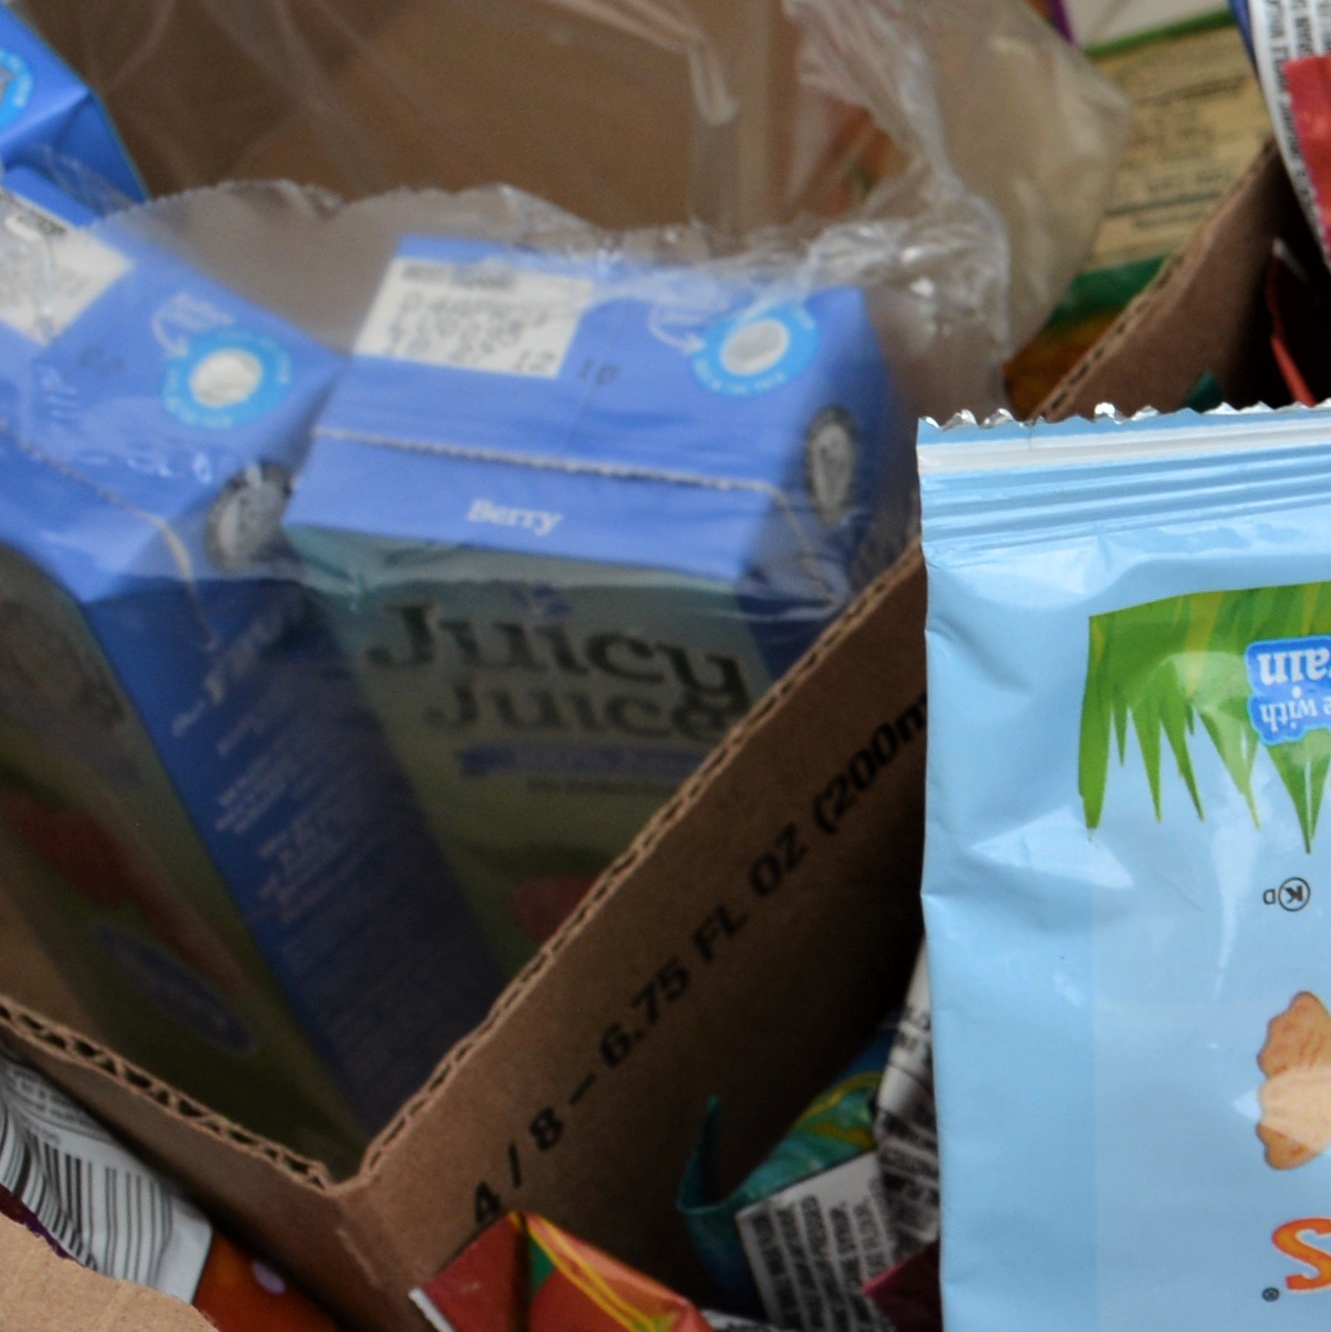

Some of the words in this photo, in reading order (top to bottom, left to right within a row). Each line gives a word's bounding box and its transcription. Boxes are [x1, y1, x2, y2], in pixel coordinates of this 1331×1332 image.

[466, 498, 565, 537] Berry
[367, 598, 749, 714] Juicy
[1260, 694, 1318, 733] with
[692, 904, 748, 962] FL
